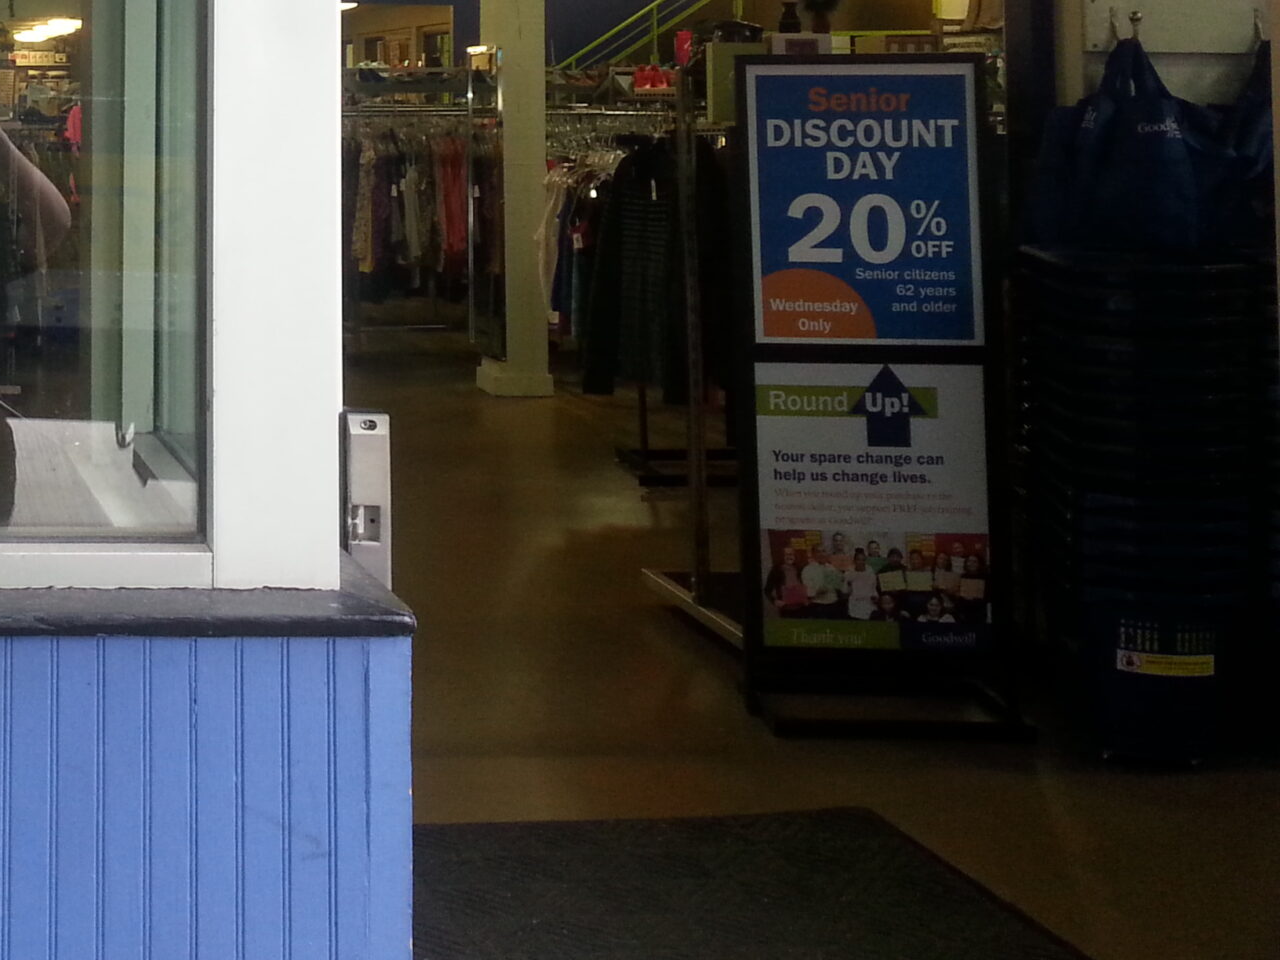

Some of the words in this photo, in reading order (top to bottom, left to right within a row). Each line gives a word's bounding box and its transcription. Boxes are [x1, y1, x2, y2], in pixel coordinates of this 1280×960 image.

[808, 87, 911, 112] Senior
[767, 119, 959, 147] DISCOUNT
[827, 152, 901, 180] DAY
[911, 241, 954, 258] OFF
[856, 268, 899, 280] Senior
[904, 268, 956, 281] citizens
[896, 285, 915, 296] 62
[920, 286, 956, 298] years
[770, 298, 858, 315] Wednesday
[892, 300, 917, 312] and
[922, 300, 956, 313] older
[798, 318, 832, 334] Only
[770, 390, 848, 412] Round
[865, 392, 910, 417] Up!
[773, 450, 805, 463] Your
[810, 451, 852, 467] spare
[856, 451, 912, 467] change
[916, 453, 944, 466] can
[774, 468, 806, 483] help
[811, 470, 828, 481] us
[833, 469, 888, 486] change
[893, 471, 932, 484] lives.
